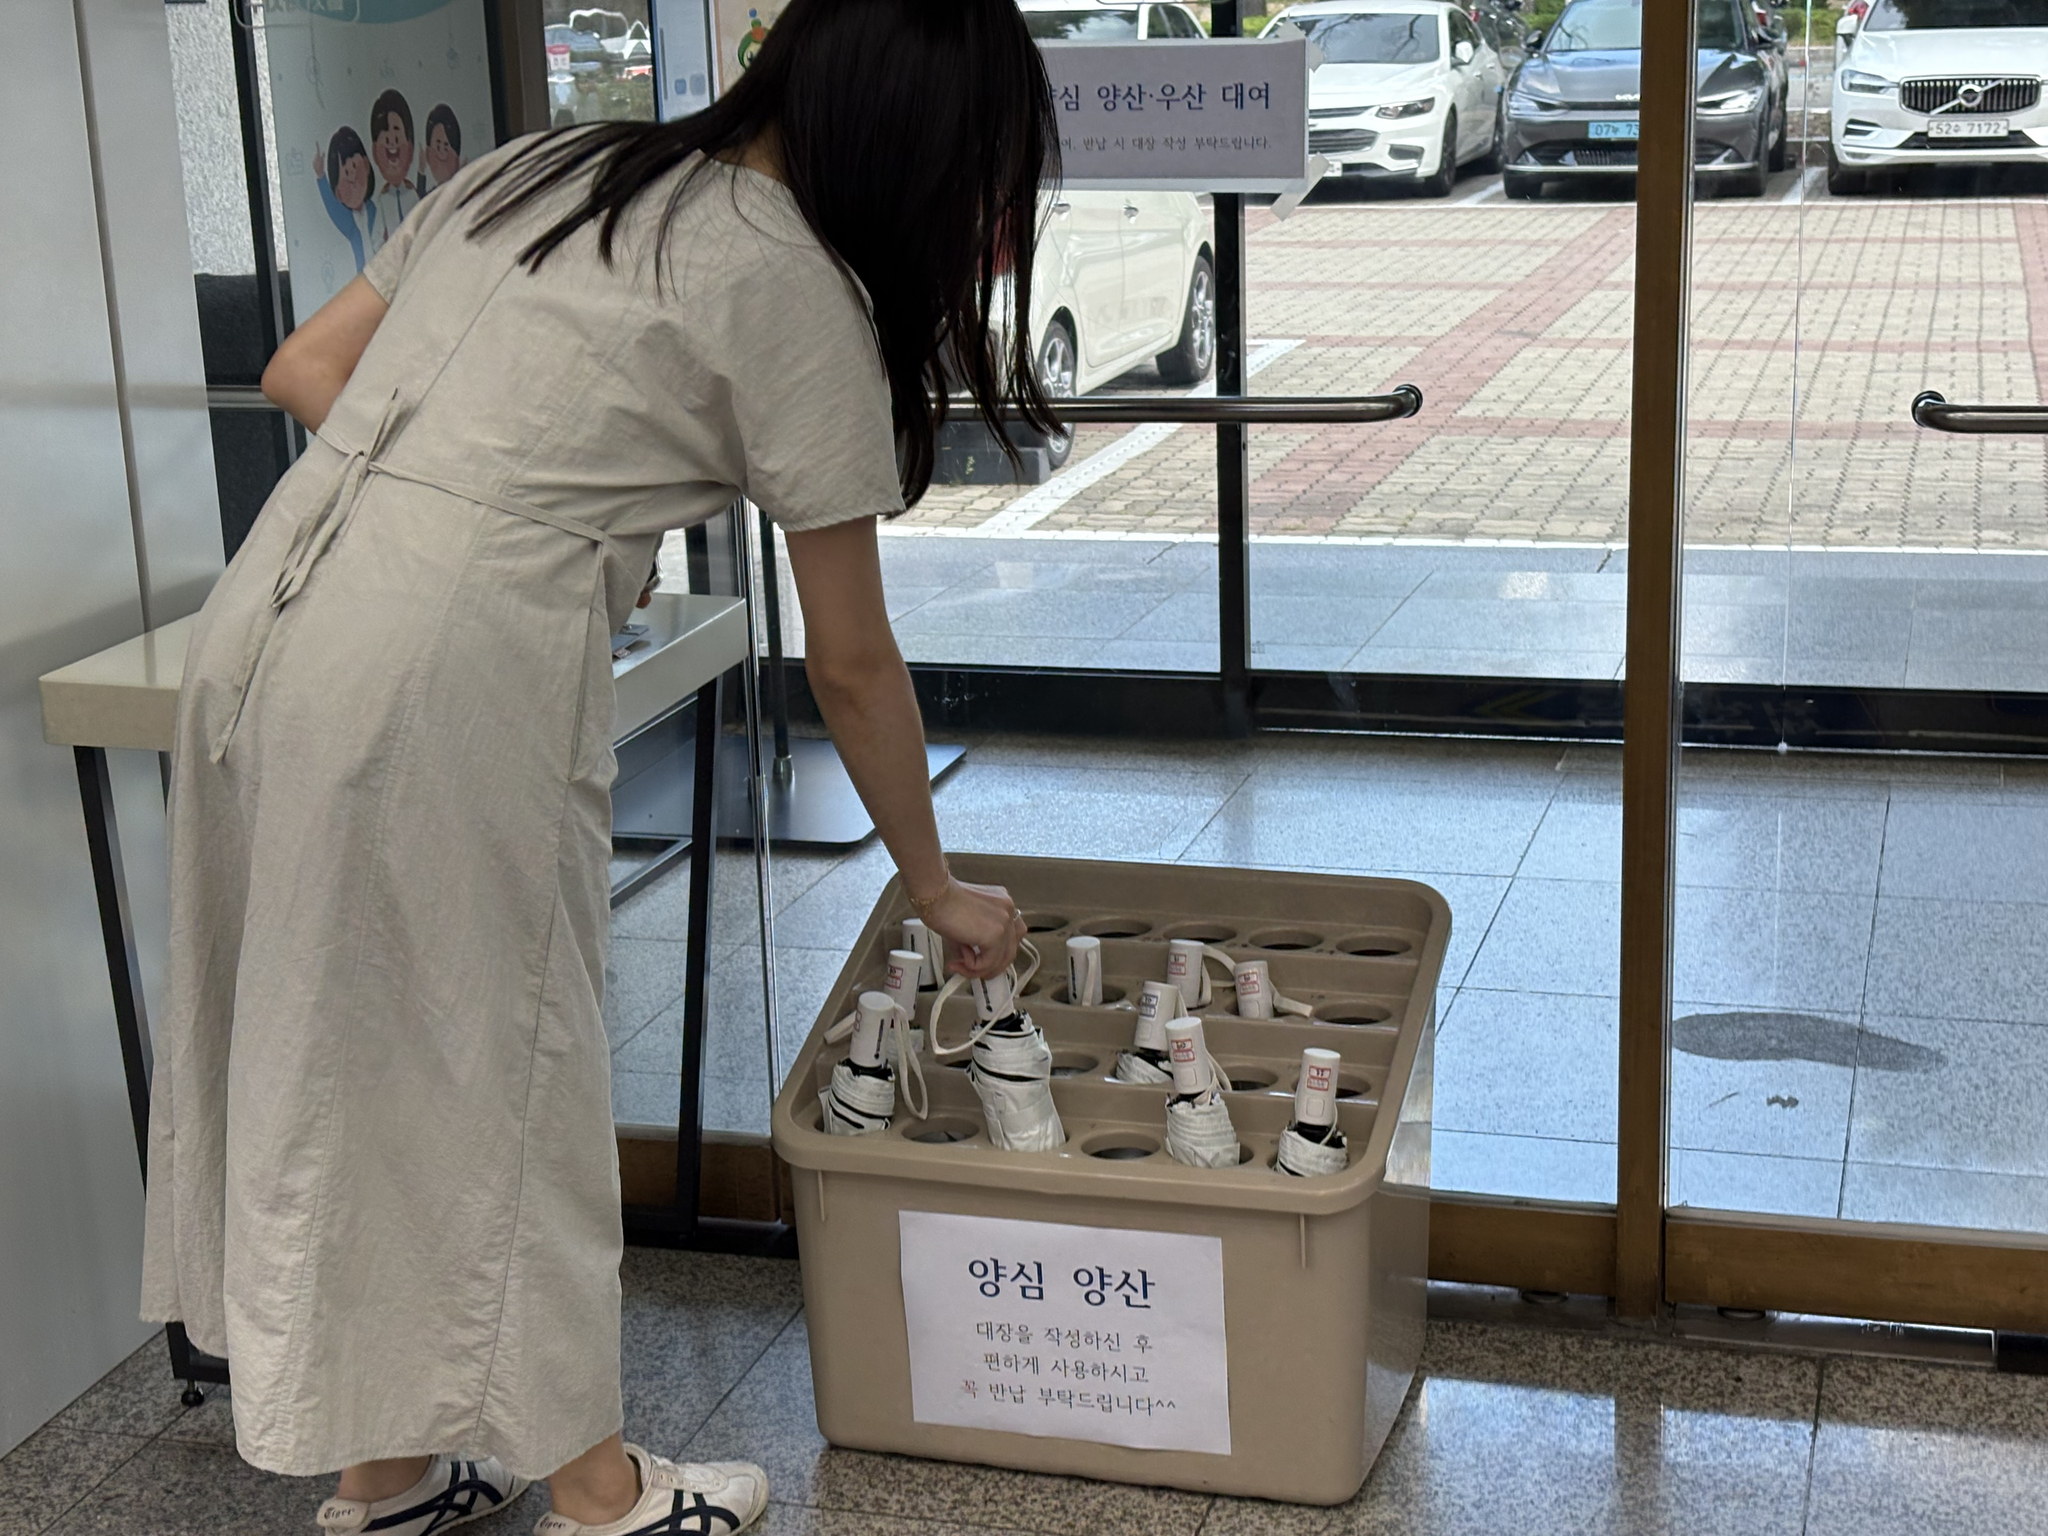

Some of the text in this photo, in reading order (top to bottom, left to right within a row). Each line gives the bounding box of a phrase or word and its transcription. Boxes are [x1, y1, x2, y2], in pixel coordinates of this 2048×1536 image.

[1051, 82, 1269, 111] 심 양산·우산 대여
[1083, 136, 1106, 151] 반납
[1113, 136, 1124, 150] 시
[1131, 136, 1154, 151] 대장
[1163, 136, 1186, 151] 작성
[1967, 122, 2000, 134] 7172
[968, 1257, 1155, 1309] 양심 양산
[976, 1321, 1152, 1354] 대장을 작성하신 후
[983, 1352, 1149, 1383] 편하게 사용하시고
[961, 1379, 1176, 1417] 꼭 반납 부탁드립니다^^
